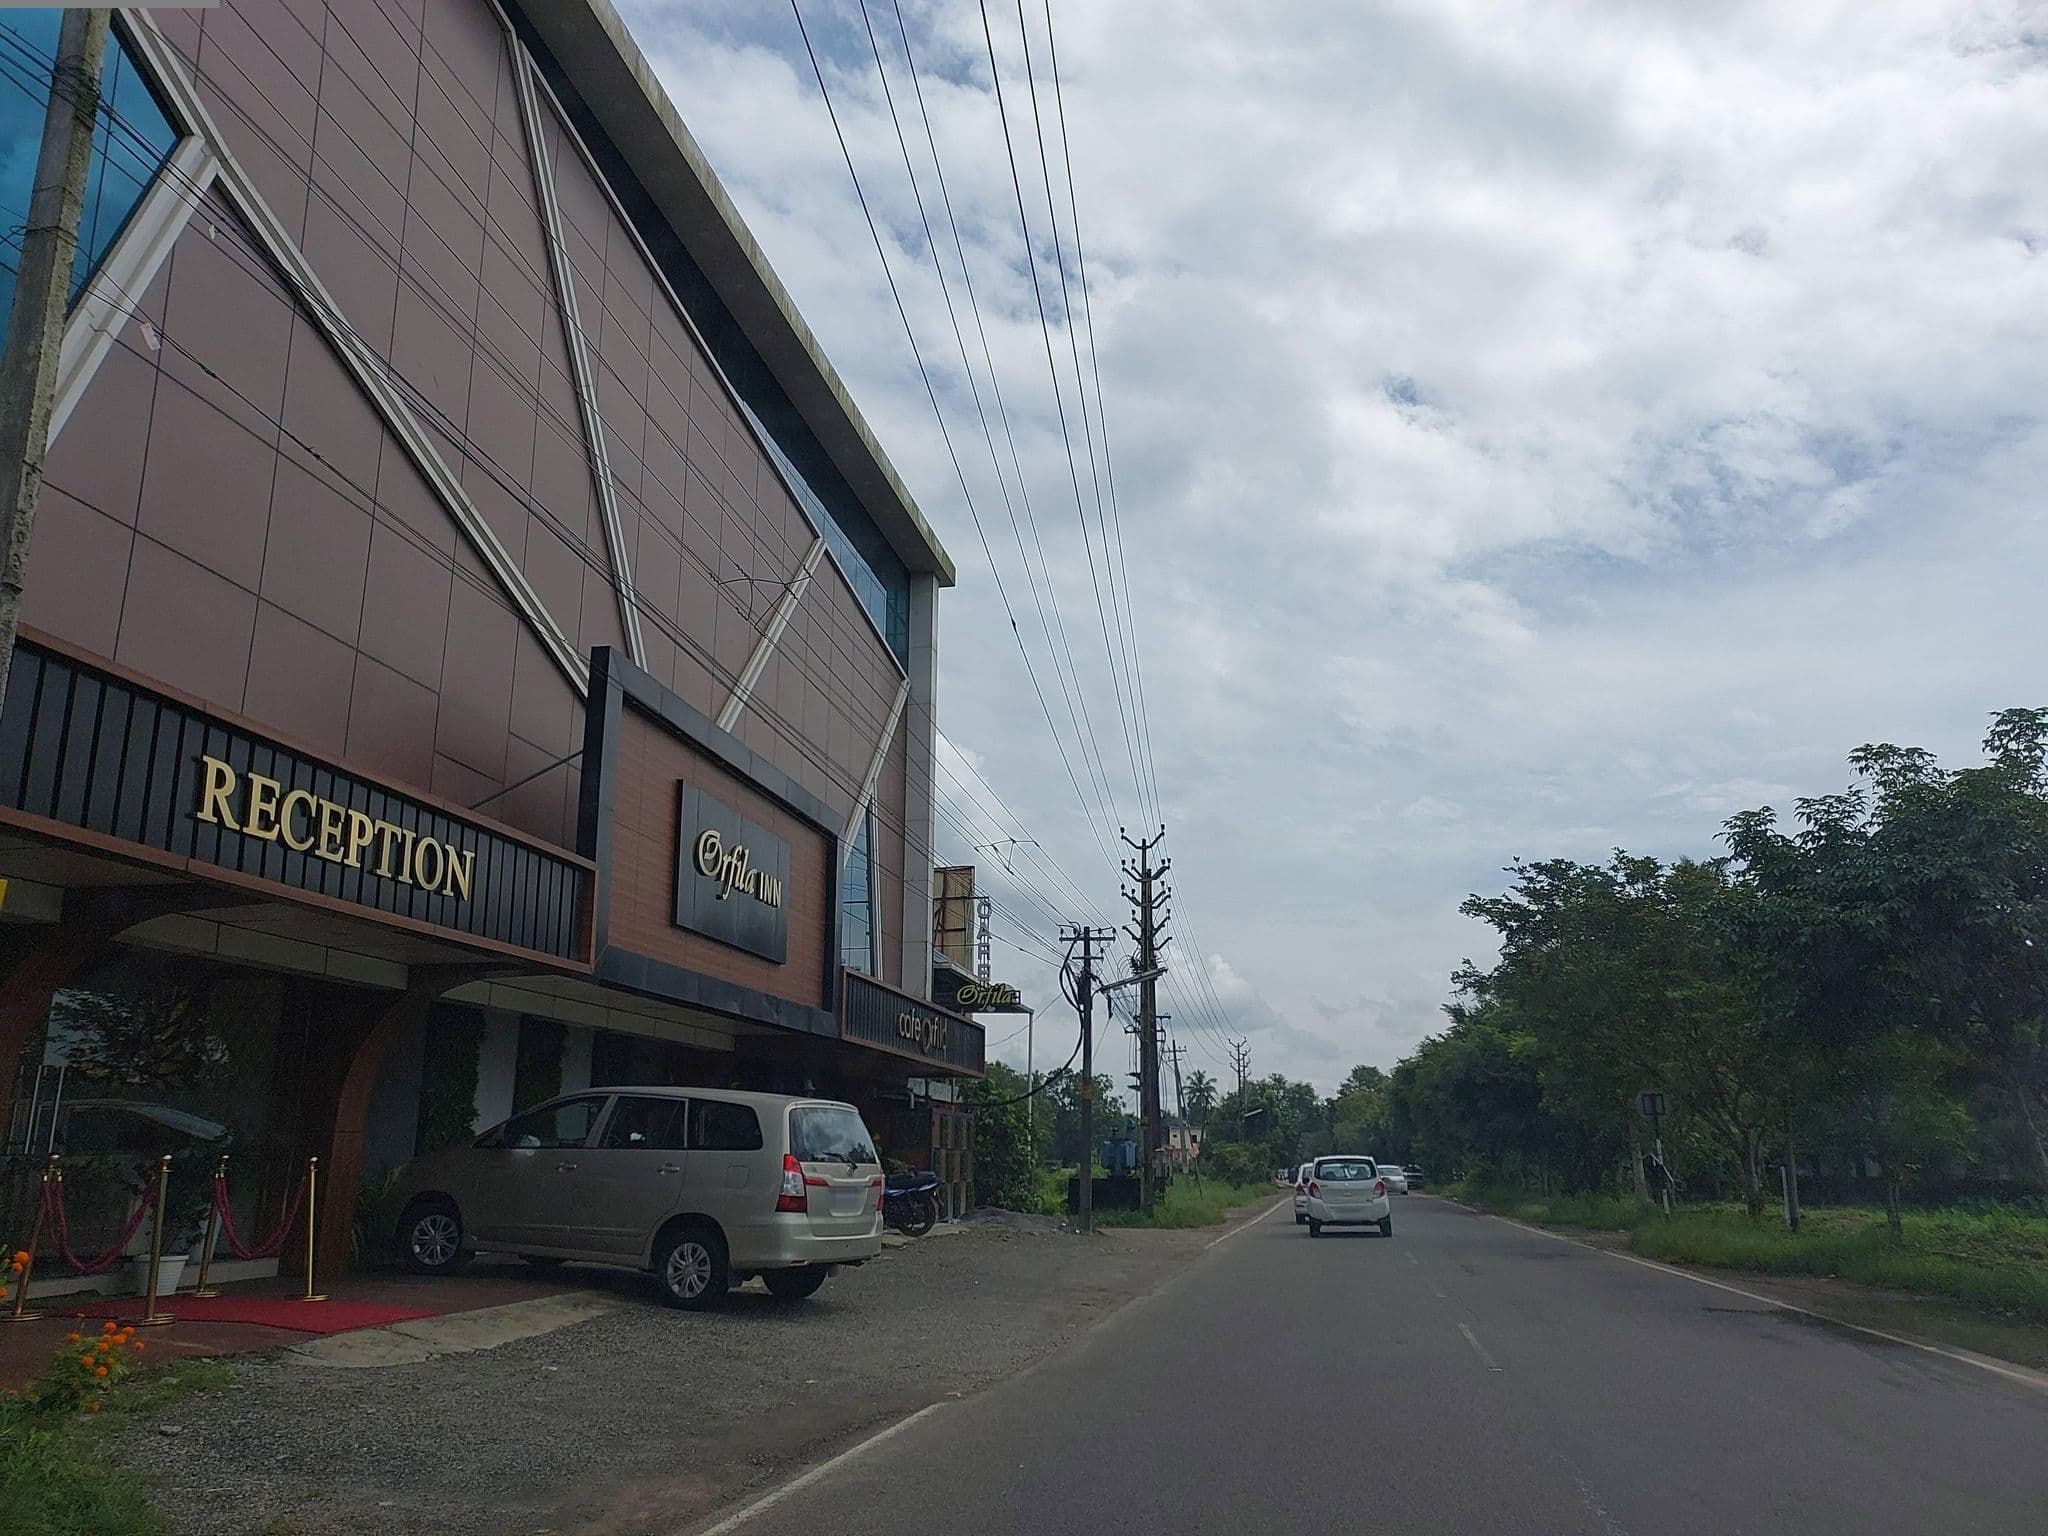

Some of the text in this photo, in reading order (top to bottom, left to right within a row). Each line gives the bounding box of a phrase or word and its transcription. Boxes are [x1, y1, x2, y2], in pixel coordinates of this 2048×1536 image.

[197, 755, 475, 901] RECEPTION
[698, 830, 782, 908] Orfila INN
[977, 900, 992, 981] CAFE
[899, 1008, 921, 1041] cafe
[957, 984, 1014, 1011] Orfila
